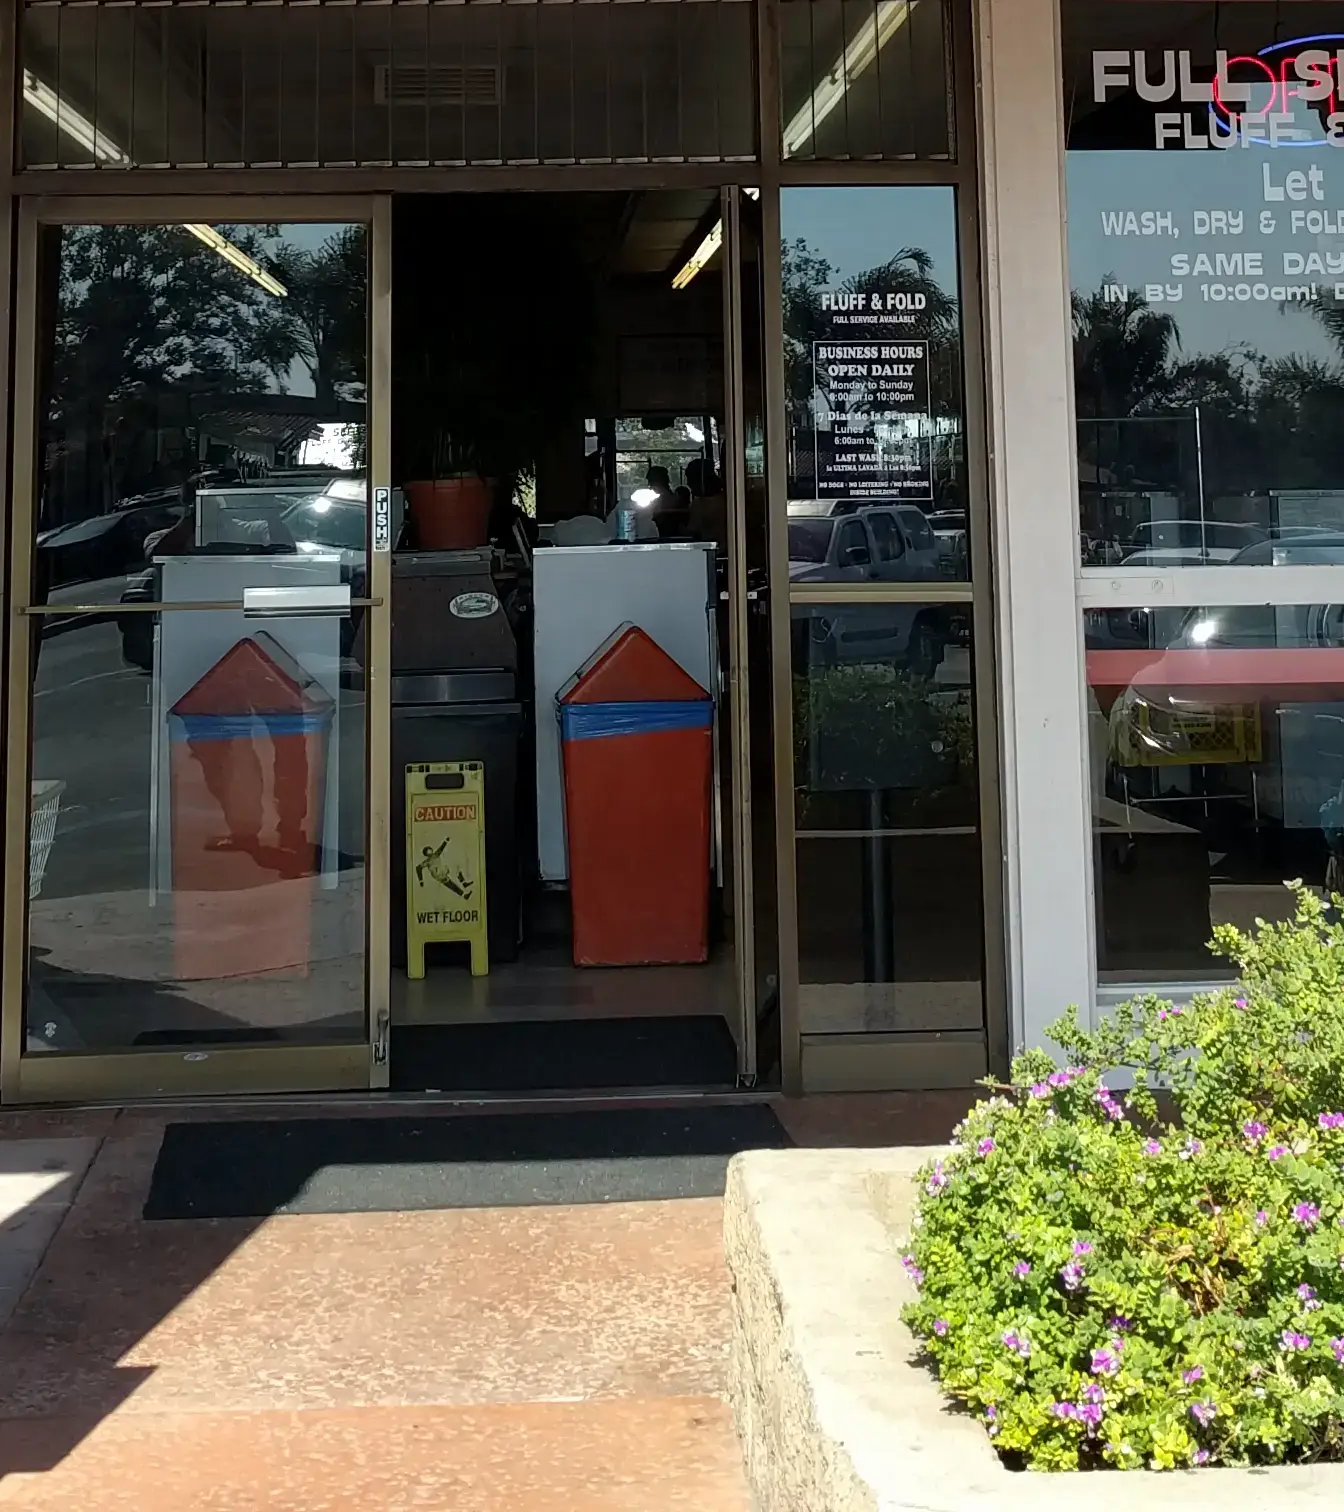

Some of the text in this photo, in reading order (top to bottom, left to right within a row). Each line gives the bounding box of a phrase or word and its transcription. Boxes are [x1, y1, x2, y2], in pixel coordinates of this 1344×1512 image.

[1092, 50, 1251, 103] FULL
[1154, 111, 1295, 149] FLUFF
[1262, 162, 1324, 202] Let
[1101, 211, 1179, 238] WASH,
[1193, 210, 1244, 235] DRY
[1259, 210, 1276, 235] &
[1170, 253, 1264, 276] SAME
[821, 292, 926, 310] FLUFF & FOLD
[1103, 284, 1128, 303] IN
[1145, 283, 1183, 302] BY
[1200, 282, 1318, 302] 10:00am!
[818, 346, 923, 359] BUSINESS HOURS
[828, 364, 915, 376] OPEN DAILY
[830, 380, 914, 391] Monday to Sunday
[865, 392, 874, 401] to
[876, 392, 915, 402] 10:00pm
[827, 411, 851, 421] Dias
[854, 411, 867, 421] de
[870, 411, 881, 421] la
[883, 411, 927, 421] Semana
[835, 453, 857, 462] LAST
[376, 490, 388, 538] PUSH
[415, 805, 476, 821] CAUTION
[417, 910, 479, 924] WET FLOOR
